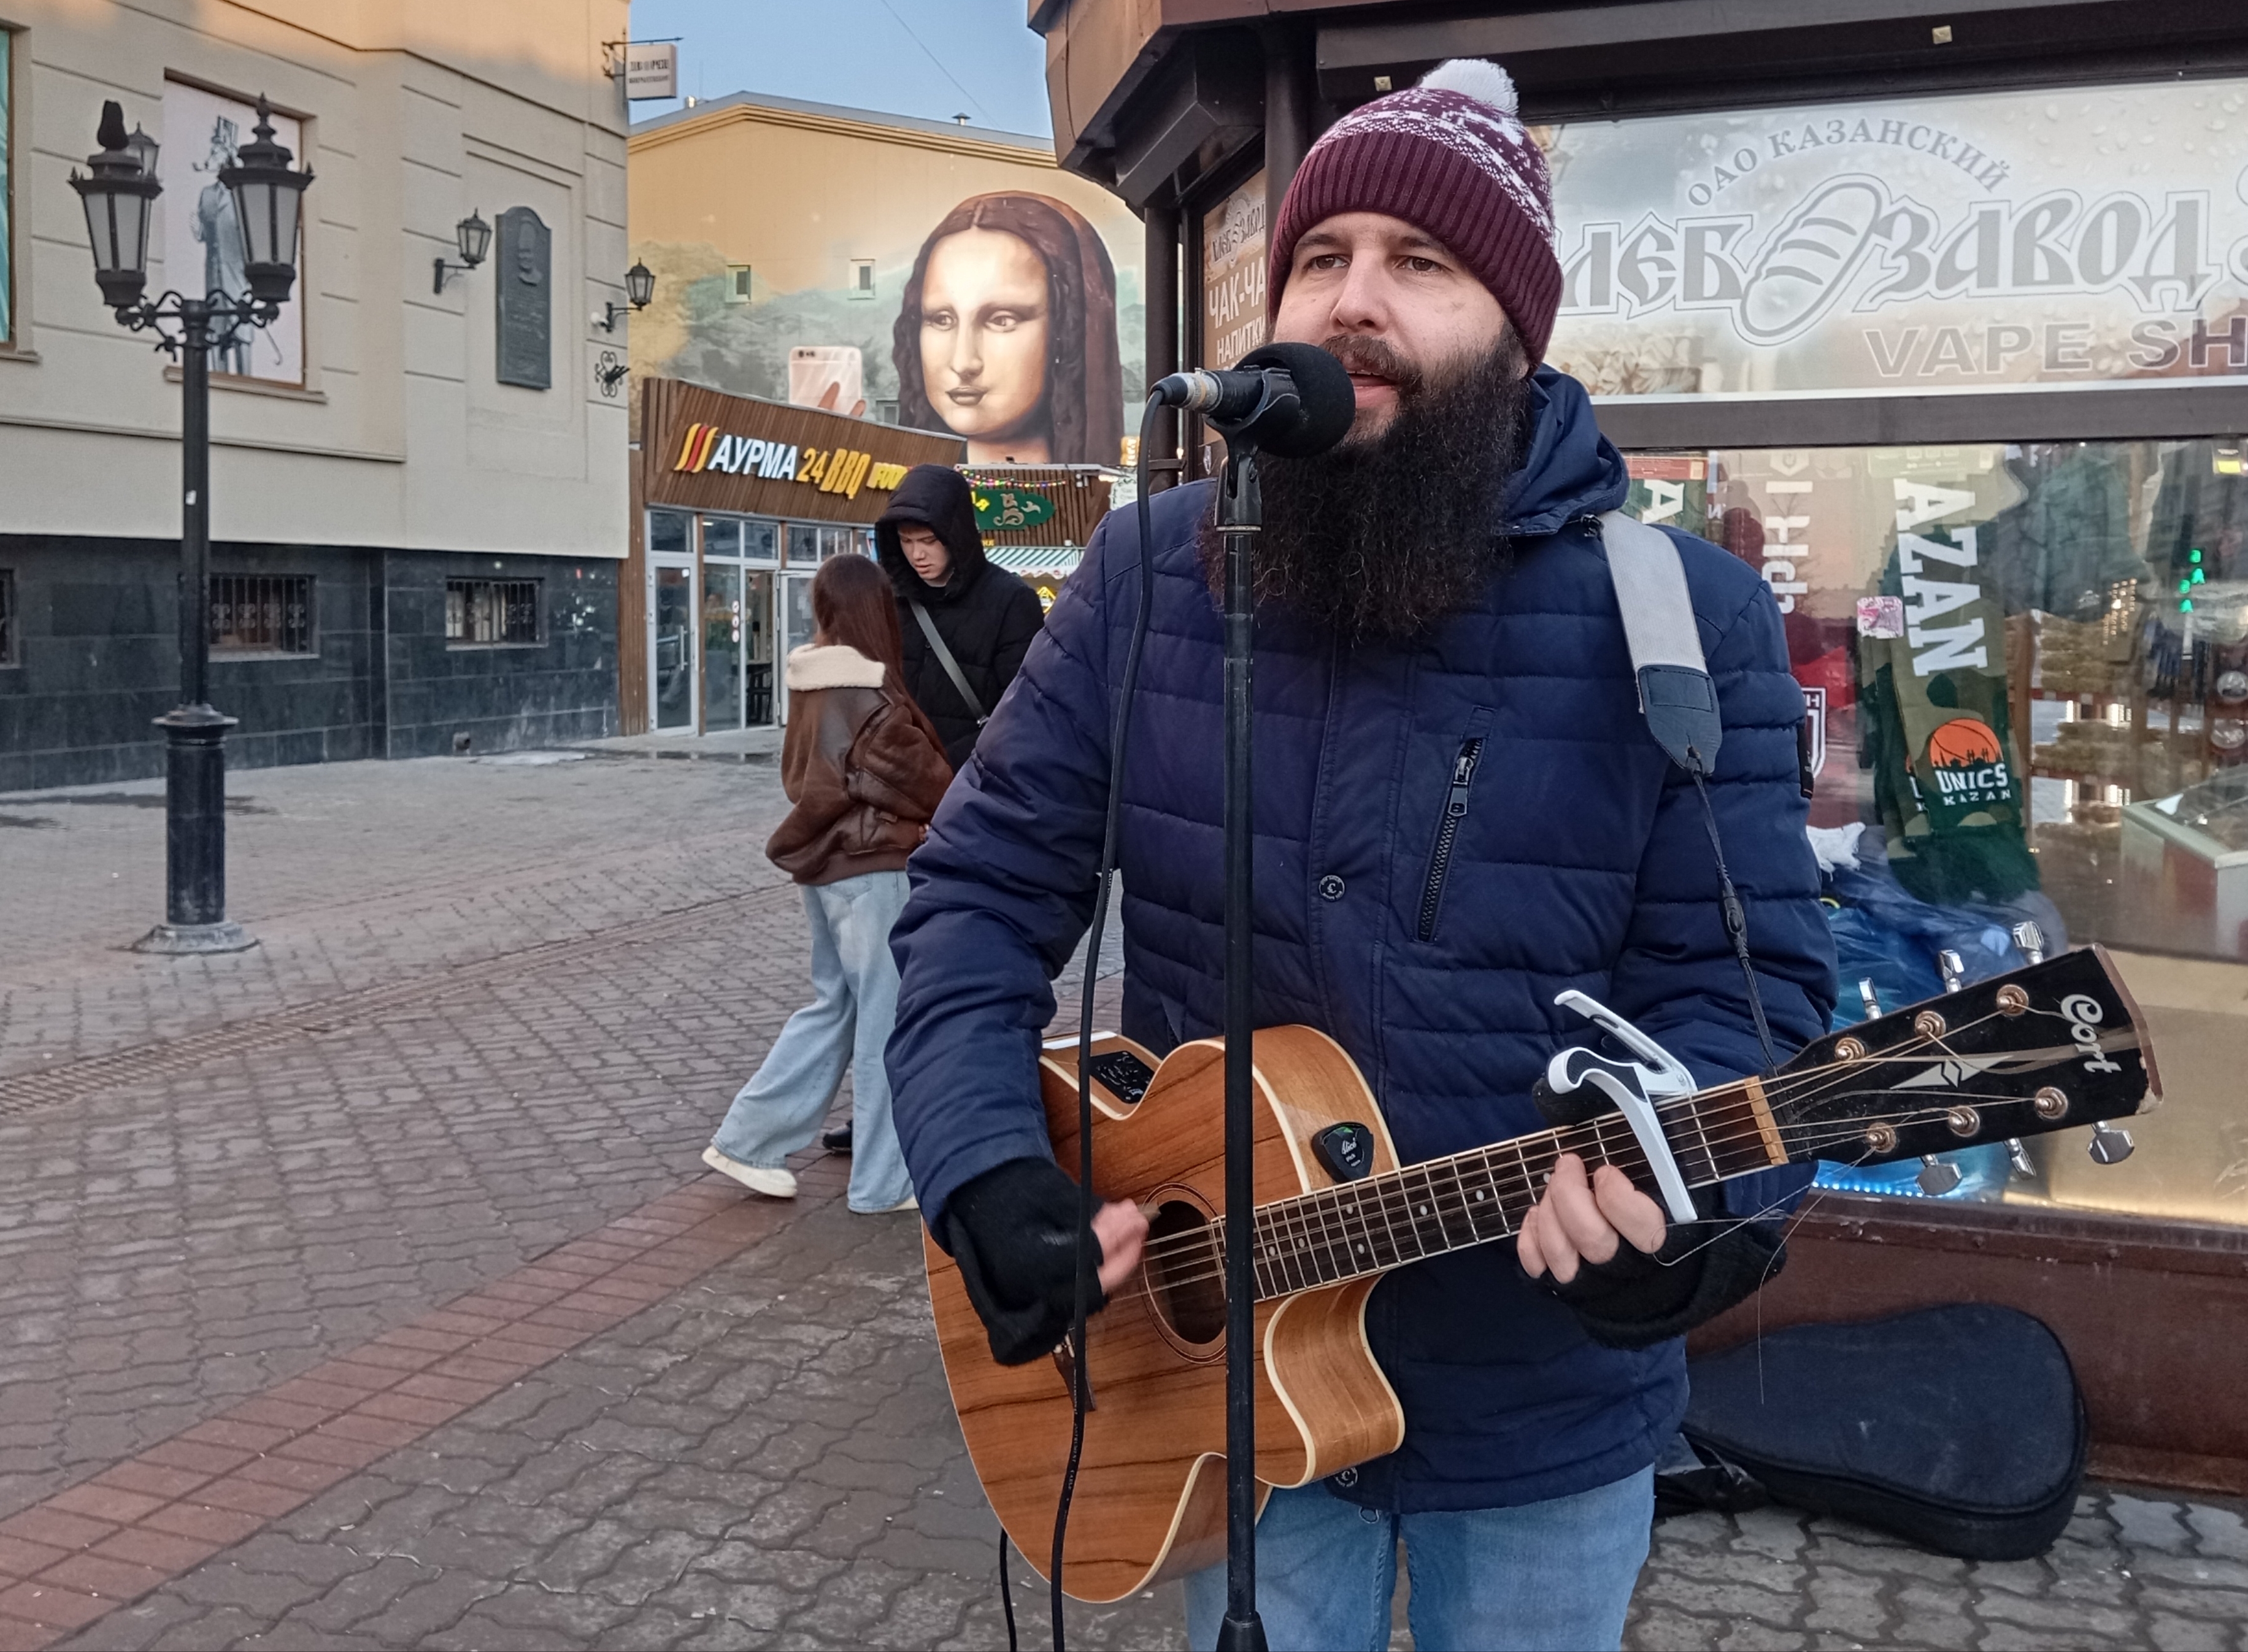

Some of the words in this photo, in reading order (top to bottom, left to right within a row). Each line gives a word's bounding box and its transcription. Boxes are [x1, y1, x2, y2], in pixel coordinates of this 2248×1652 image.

[1688, 147, 1758, 206] ОАО
[1768, 118, 2010, 193] КАЗАНСКИЙ
[1209, 256, 1266, 329] ЧАК-ЧА
[1562, 223, 1744, 307] ЛЕБ
[1864, 322, 2093, 377] VAPE
[796, 448, 828, 483] 24
[820, 448, 871, 500] BBQ
[866, 461, 907, 490] FOO
[1893, 478, 1988, 677] AZAN
[1934, 762, 2009, 794] UNICS
[1942, 789, 2012, 807] KAZAN
[2060, 994, 2123, 1074] Cort
